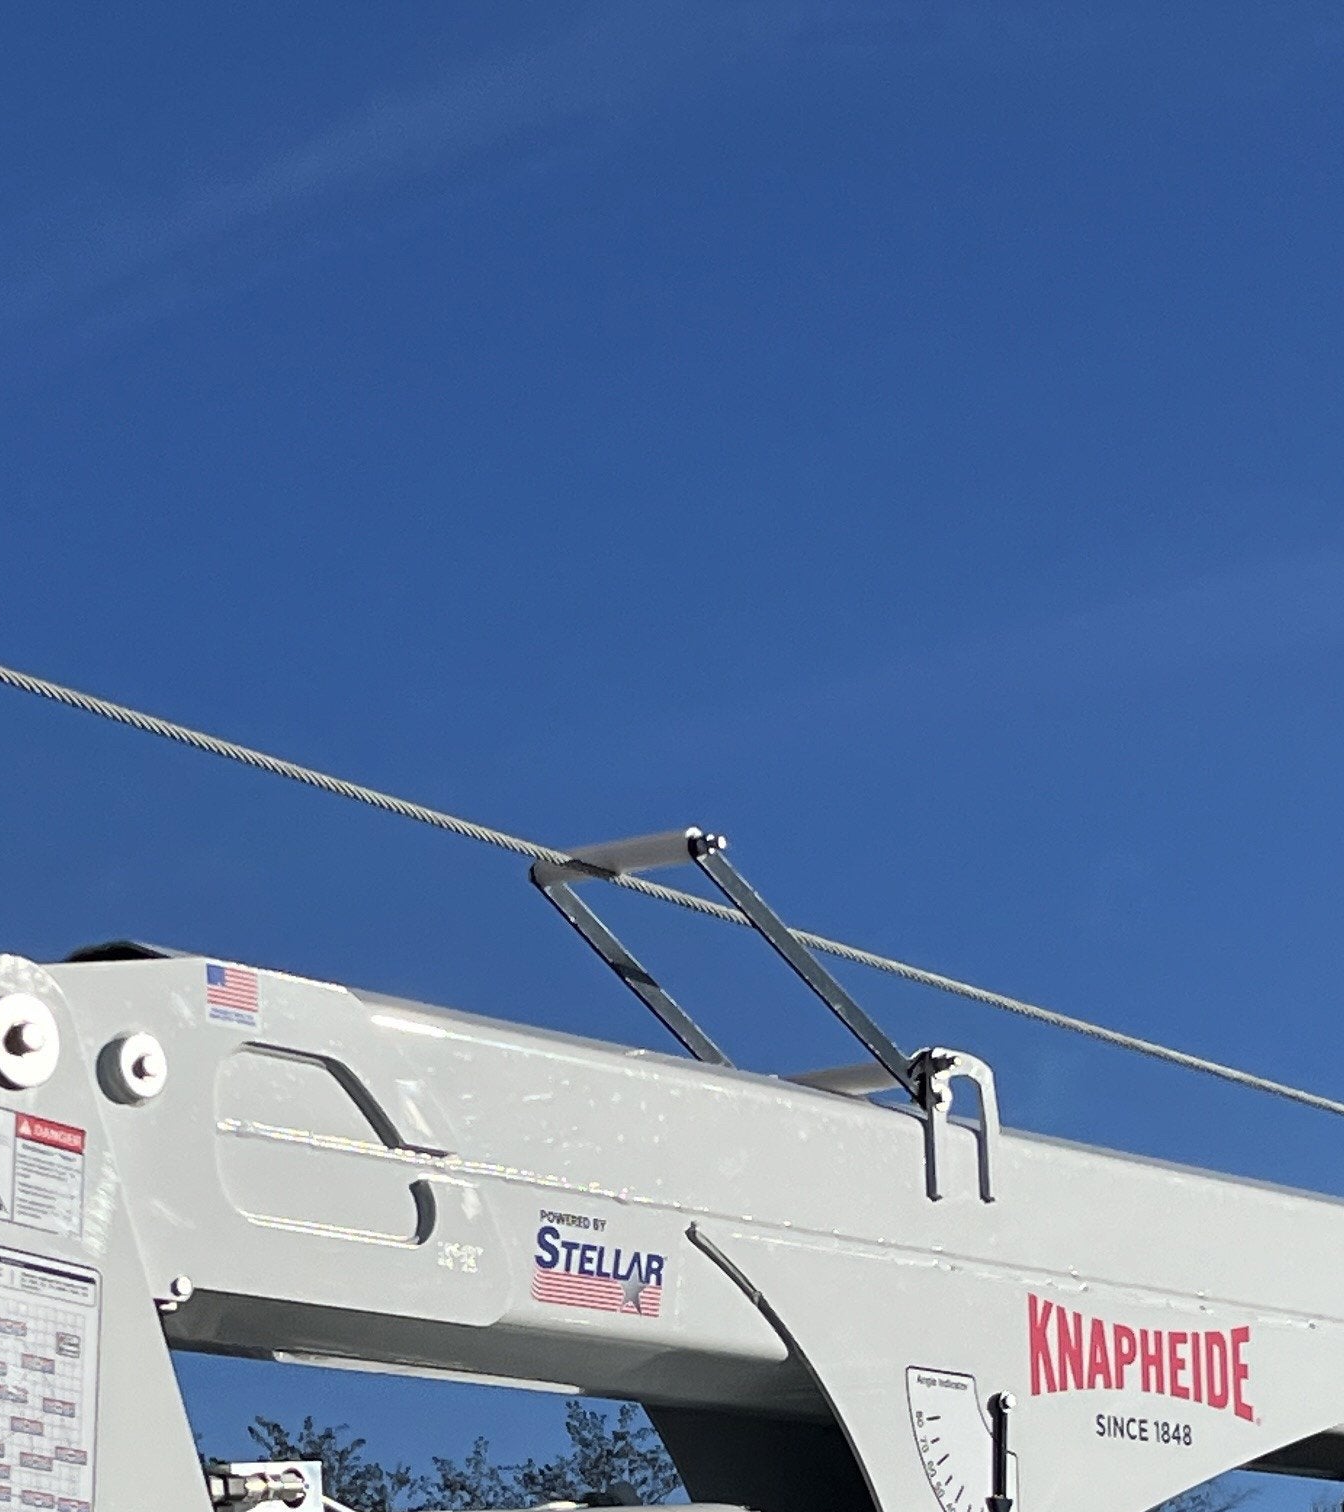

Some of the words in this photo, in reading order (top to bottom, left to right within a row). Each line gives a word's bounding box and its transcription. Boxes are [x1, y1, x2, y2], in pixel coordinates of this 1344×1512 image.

[539, 1209, 591, 1230] POWERED
[592, 1217, 607, 1232] BY
[1027, 1292, 1254, 1423] KNAPHEIDE
[1095, 1413, 1149, 1442] SINCE
[1153, 1420, 1193, 1446] 1848
